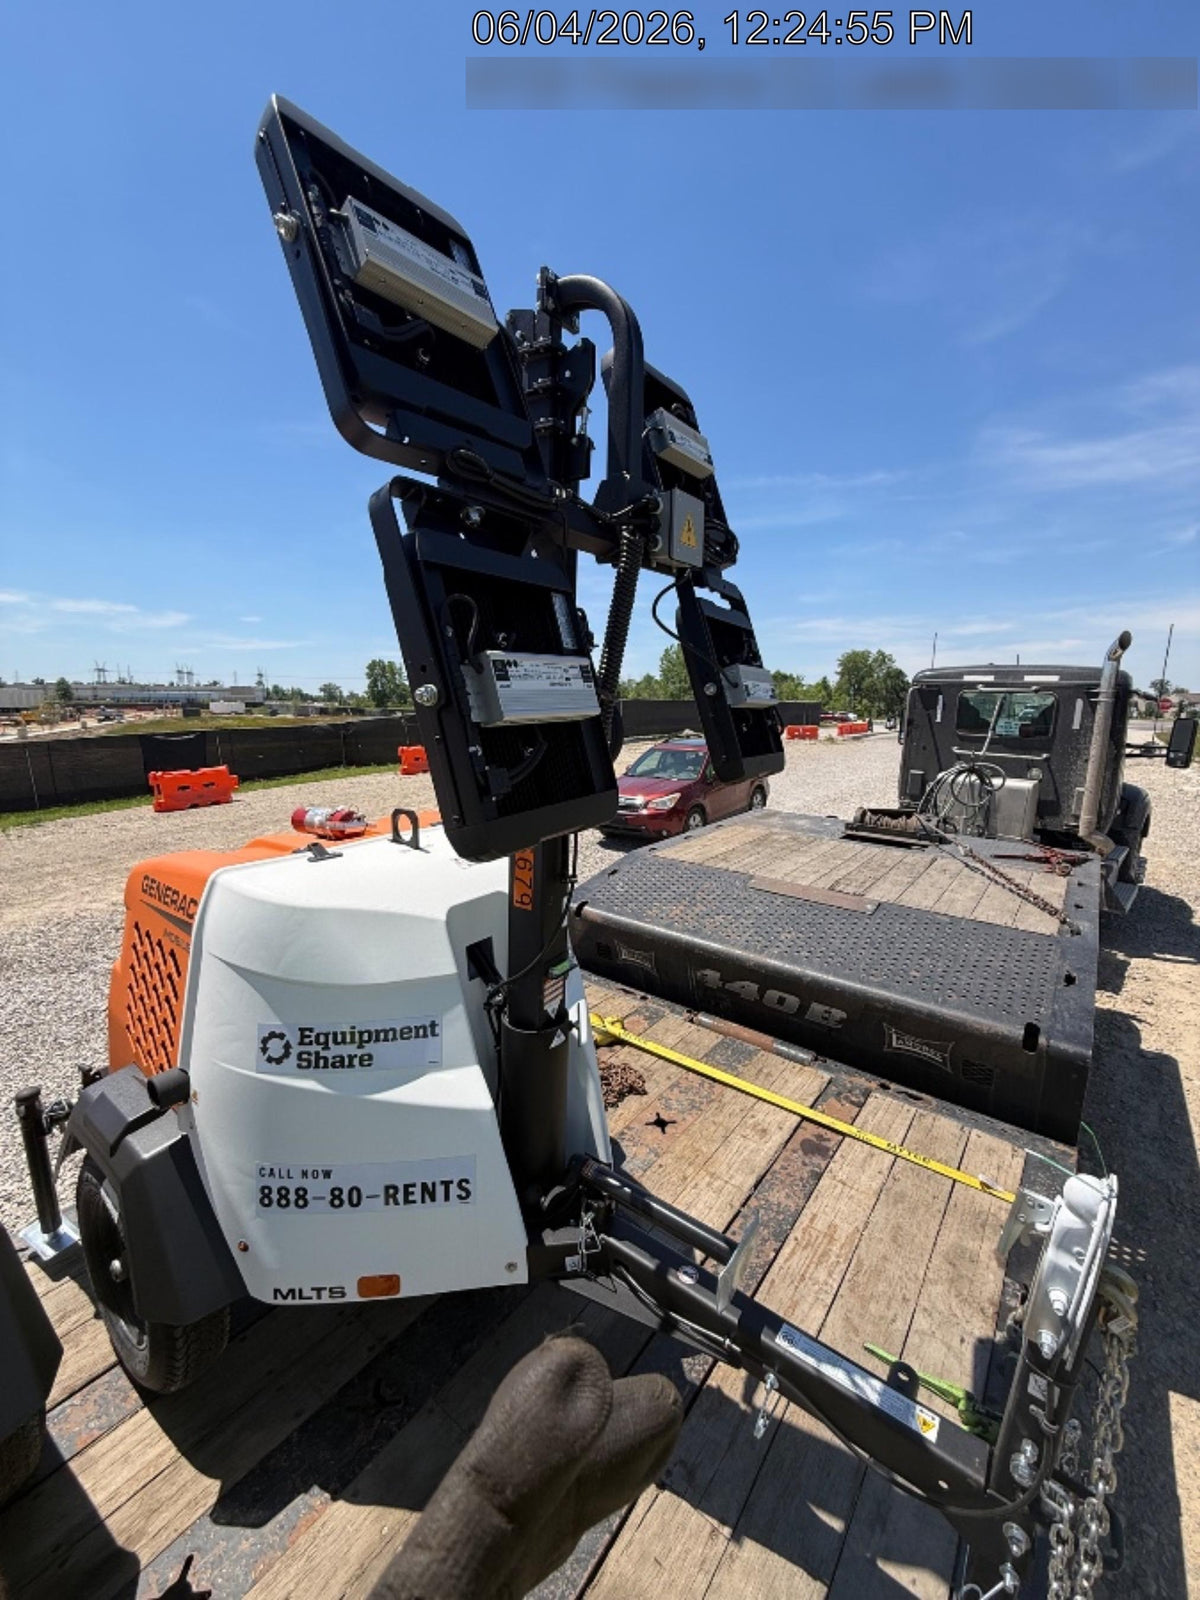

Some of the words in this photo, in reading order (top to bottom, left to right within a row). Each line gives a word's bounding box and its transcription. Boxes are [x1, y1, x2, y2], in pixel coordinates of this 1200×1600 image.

[141, 874, 199, 920] GENERAC
[297, 1020, 439, 1050] Equipment
[296, 1050, 374, 1070] Share
[258, 1166, 294, 1180] CALL
[301, 1168, 333, 1180] NOW
[258, 1178, 472, 1210] 888-80-RENTS
[273, 1286, 347, 1301] MLTS
